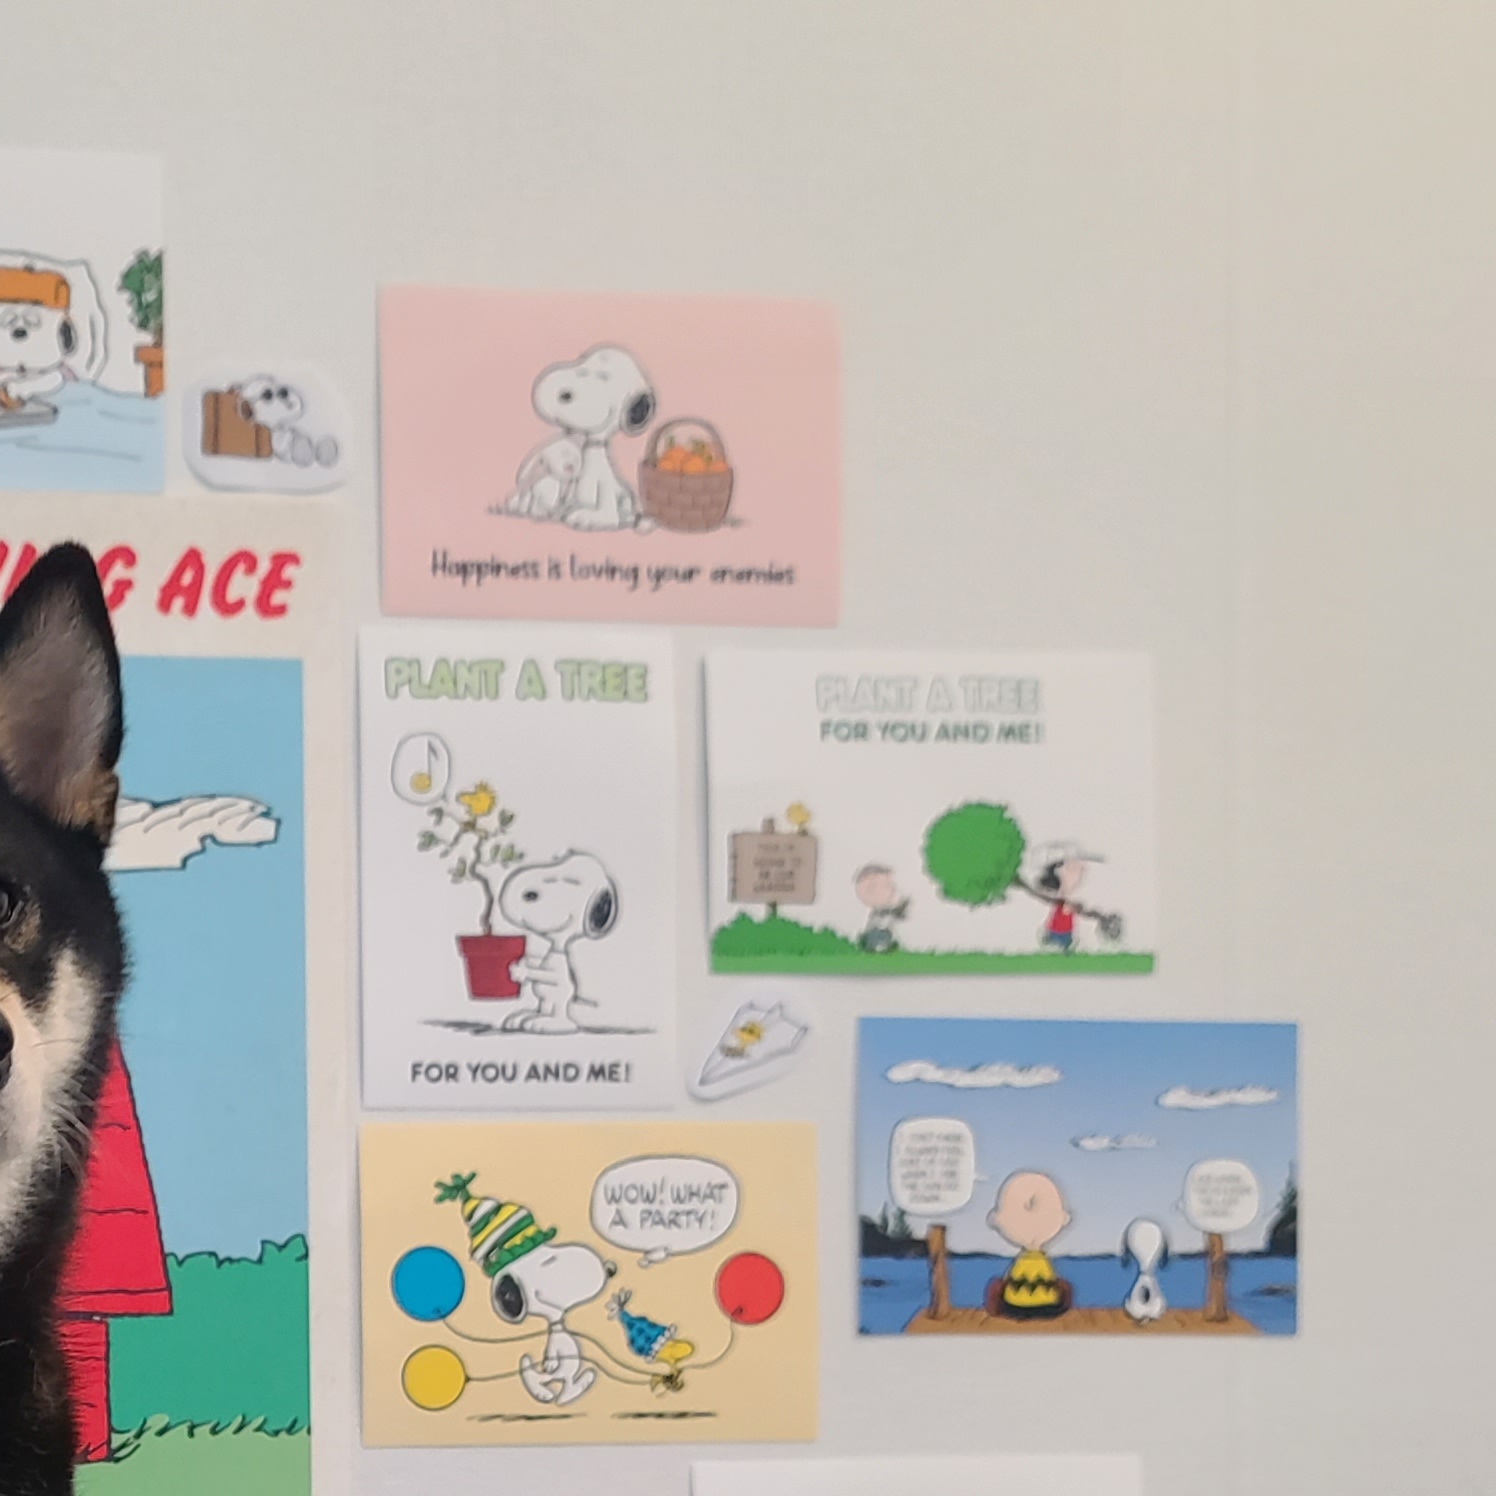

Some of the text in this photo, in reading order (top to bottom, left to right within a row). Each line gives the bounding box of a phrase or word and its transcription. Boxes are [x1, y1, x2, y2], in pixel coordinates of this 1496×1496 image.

[156, 547, 302, 620] ACE
[431, 549, 541, 588] Happiness
[547, 556, 562, 580] is
[570, 553, 639, 592] loving
[646, 565, 702, 593] your
[383, 656, 649, 703] PLANT A TREE
[815, 674, 1042, 716] PLANT A TREE
[819, 720, 1043, 744] FOR YOU AND ME!
[411, 1062, 632, 1083] FOR YOU AND ME!
[604, 1176, 729, 1206] WOW! WHAT
[608, 1207, 716, 1231] A PARTY!
